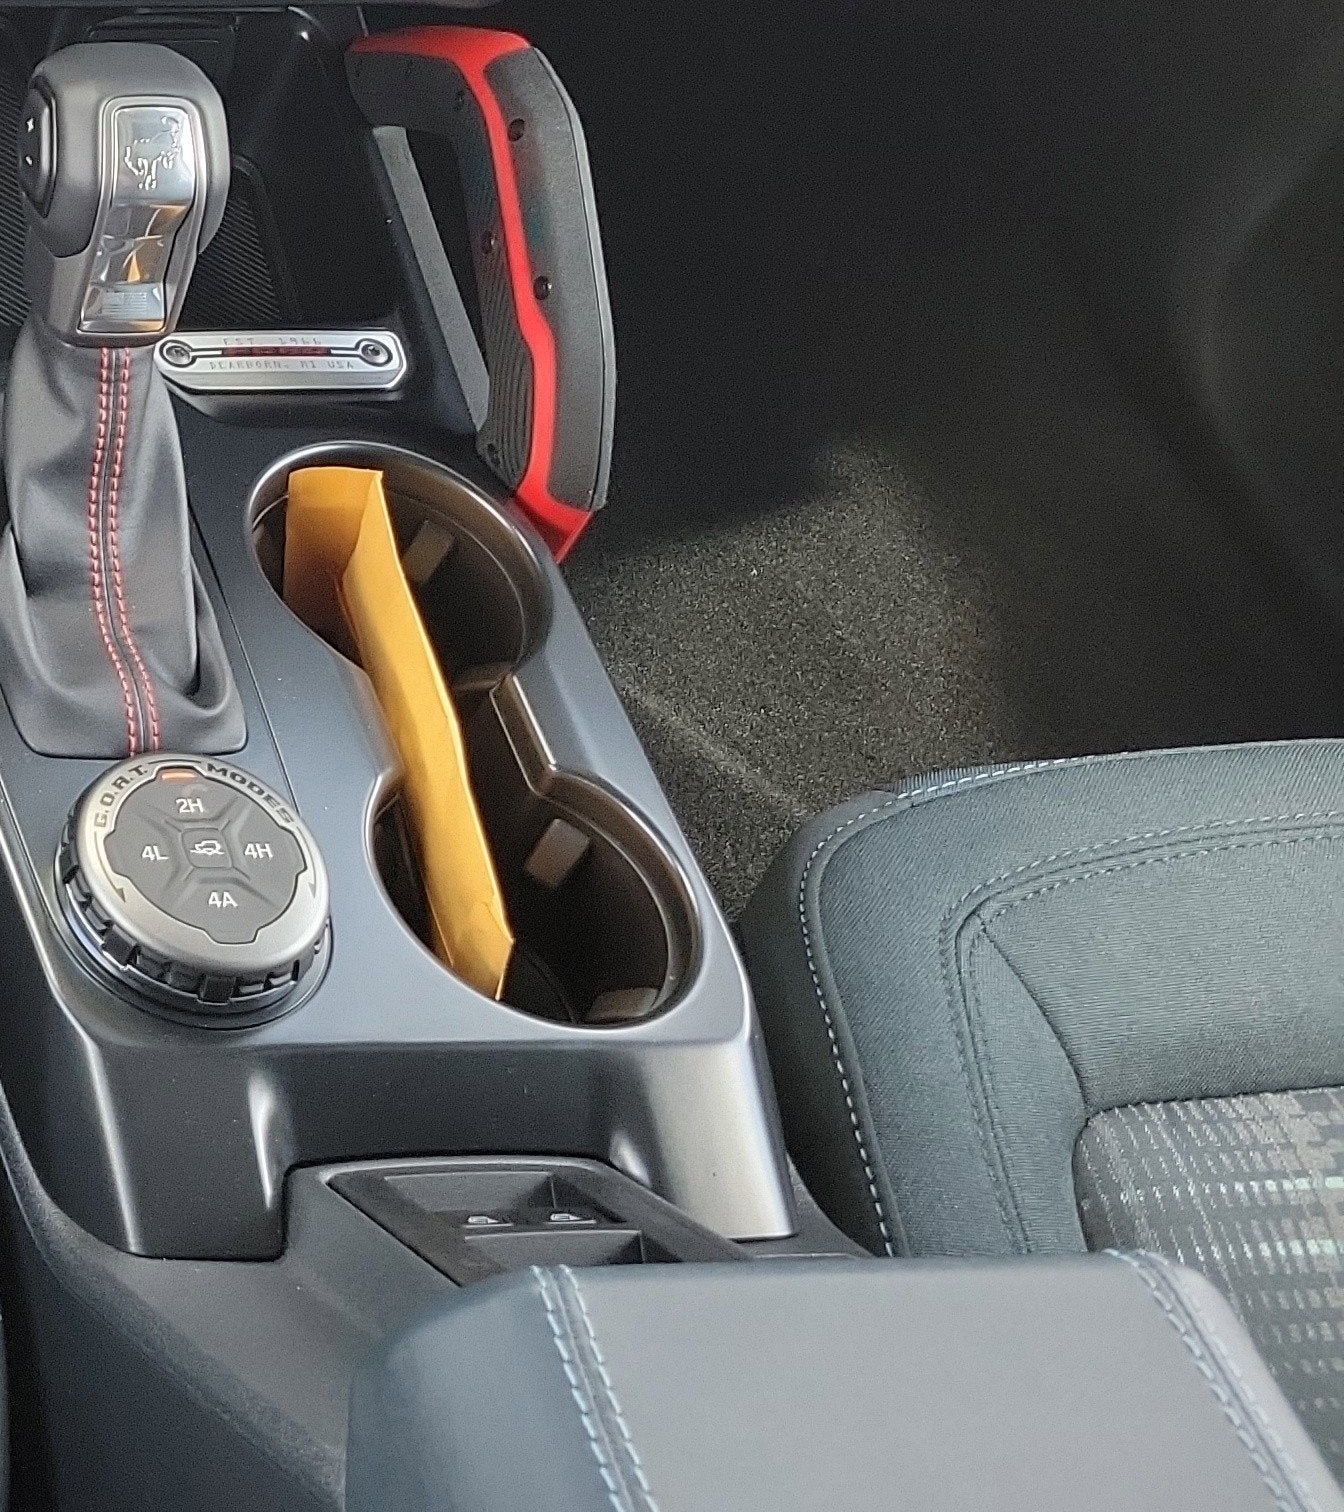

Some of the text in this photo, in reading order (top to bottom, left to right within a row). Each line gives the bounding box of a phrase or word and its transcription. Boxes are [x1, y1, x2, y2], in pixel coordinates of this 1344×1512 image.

[206, 761, 295, 825] MODES
[175, 797, 205, 814] 2H
[141, 844, 169, 862] 4L
[244, 842, 274, 859] 4H
[207, 891, 239, 908] 4A
